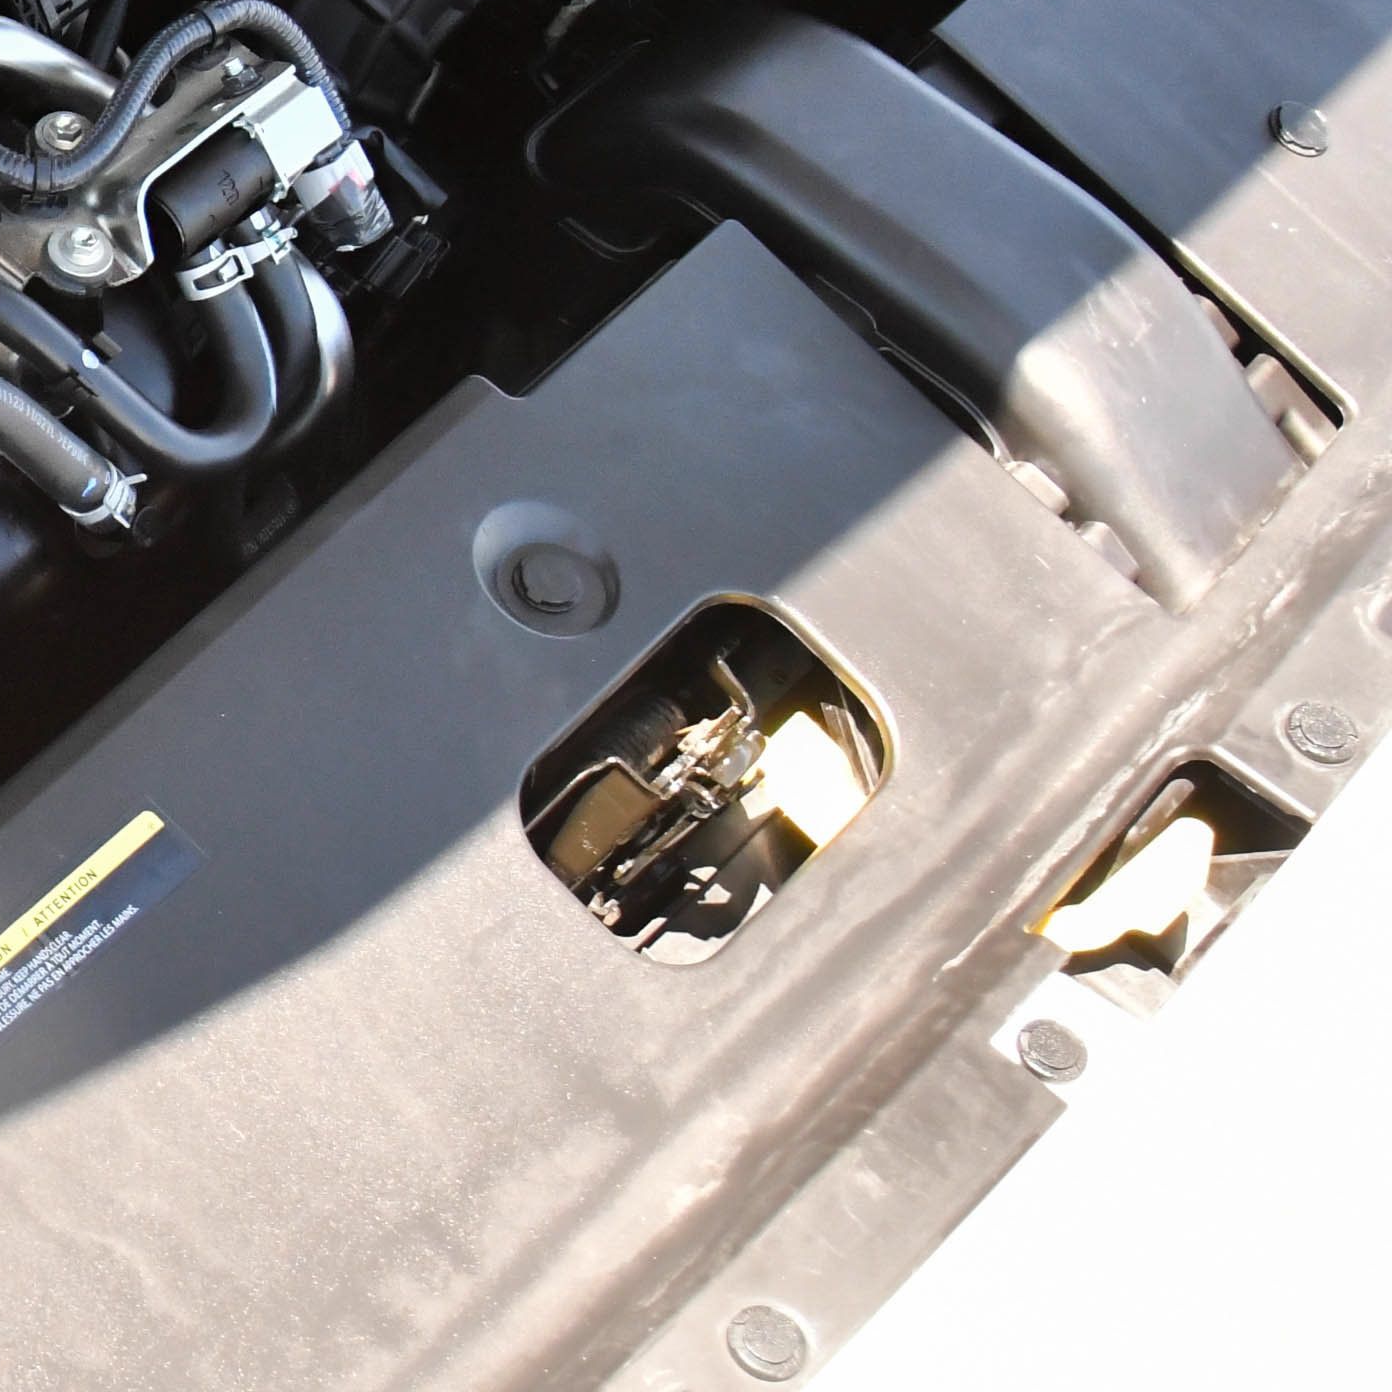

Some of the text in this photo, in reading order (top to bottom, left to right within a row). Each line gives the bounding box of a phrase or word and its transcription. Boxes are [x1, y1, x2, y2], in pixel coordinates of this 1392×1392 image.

[31, 869, 98, 926] ATTENTION
[11, 966, 31, 983] KEEP
[26, 947, 53, 970] HANDS
[26, 988, 42, 1001] NE
[36, 977, 56, 993] PAS
[50, 968, 66, 981] EN
[60, 935, 104, 972] APPROCHER
[98, 924, 116, 939] LES
[49, 946, 72, 965] TOUT
